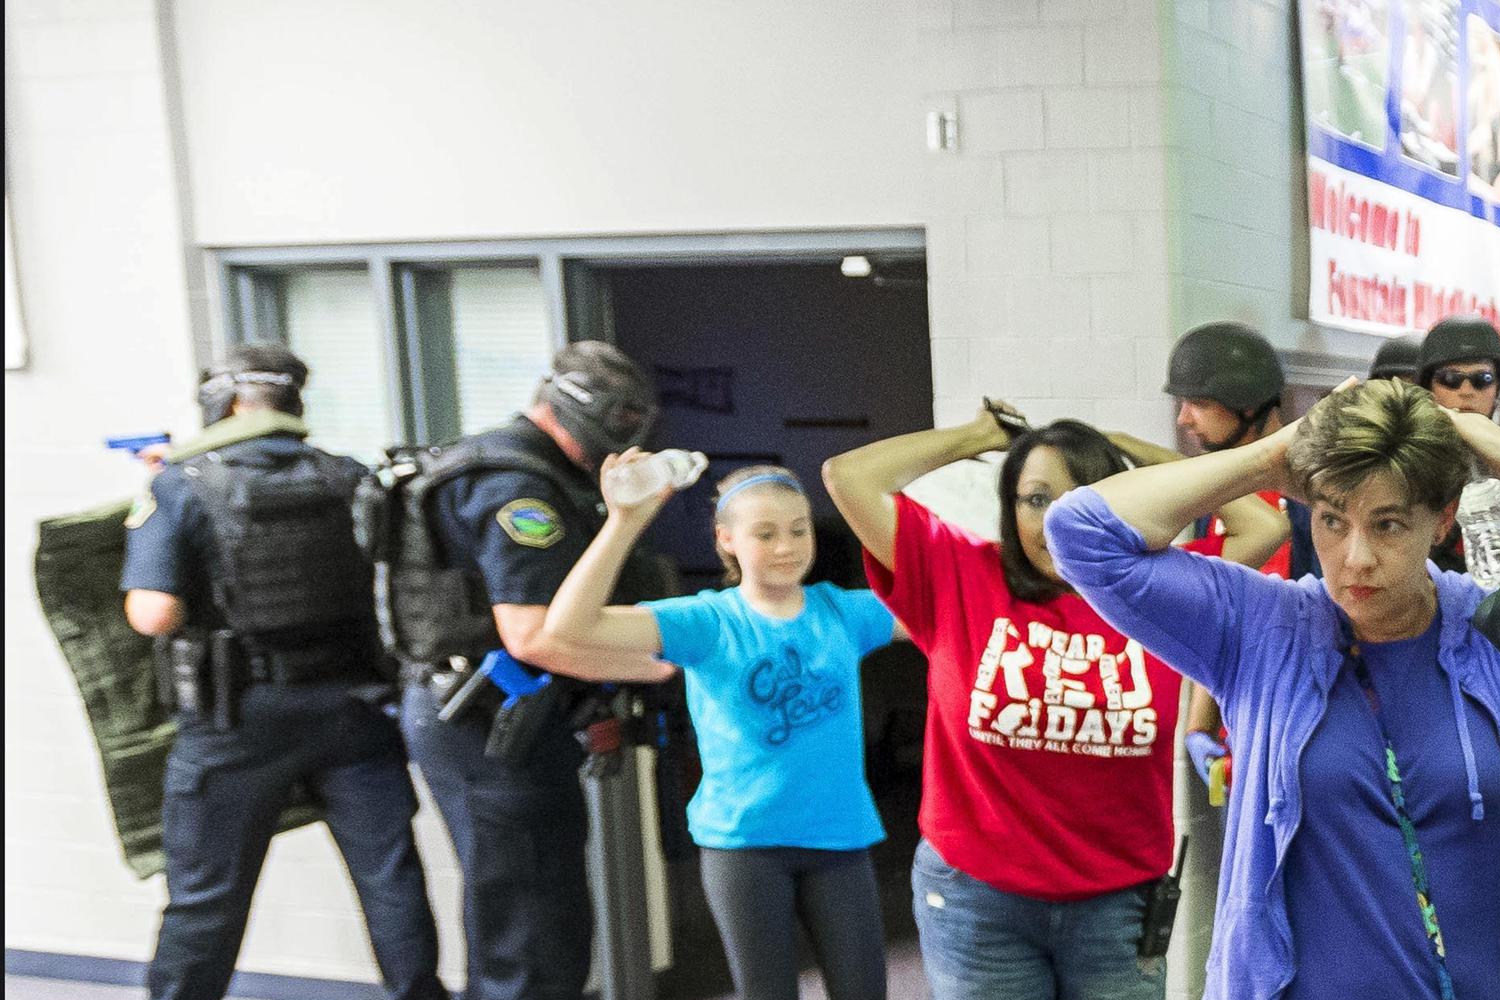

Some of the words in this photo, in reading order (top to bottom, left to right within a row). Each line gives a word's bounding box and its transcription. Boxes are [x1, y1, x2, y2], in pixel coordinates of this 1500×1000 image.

[1028, 621, 1106, 661] WEAR
[974, 617, 1153, 710] RED
[1008, 737, 1043, 752] THEY
[1044, 740, 1070, 754] ALL
